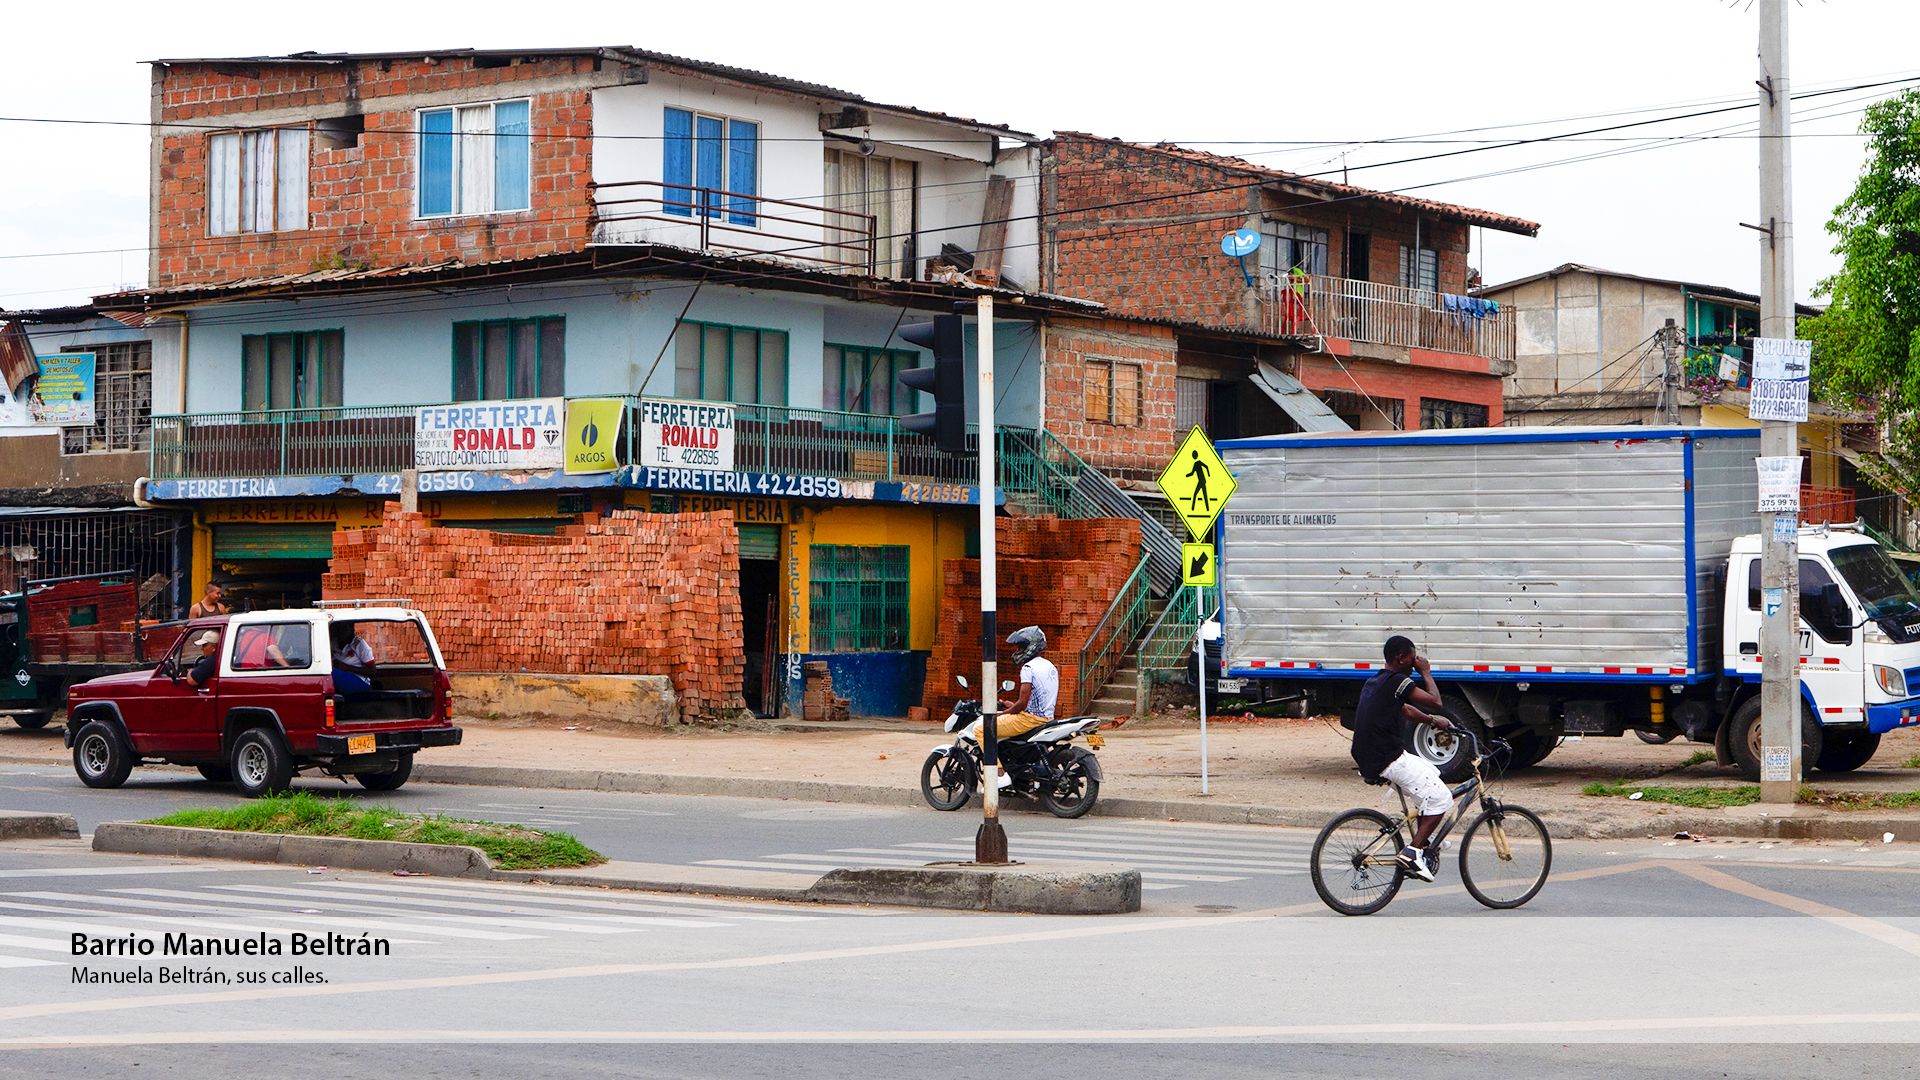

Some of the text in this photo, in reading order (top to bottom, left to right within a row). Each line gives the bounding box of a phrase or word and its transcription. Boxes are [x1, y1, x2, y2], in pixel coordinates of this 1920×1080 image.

[1756, 339, 1810, 358] SOPORTES
[1752, 380, 1808, 401] 3186785410
[421, 405, 557, 430] FERRETERIA
[641, 402, 733, 429] FERRETERIA
[1750, 399, 1807, 418] 3122369543
[453, 427, 536, 451] RONALD
[661, 425, 719, 449] RONALD
[415, 451, 457, 466] SERVICIO
[461, 450, 508, 465] DOMICILIO
[574, 452, 606, 463] ARGOS
[656, 447, 719, 466] TEL. 4228596
[177, 471, 474, 498] FERRETERIA 428596
[646, 467, 751, 492] FERRETERIA
[902, 484, 970, 503] 4228596
[216, 501, 339, 521] FERRETERIA
[681, 497, 784, 522] FERRETERIA
[1231, 515, 1337, 525] TRANSPORTE DE ALIMENTOS
[790, 530, 802, 679] ELECTRICOS
[1904, 622, 1920, 636] FOT
